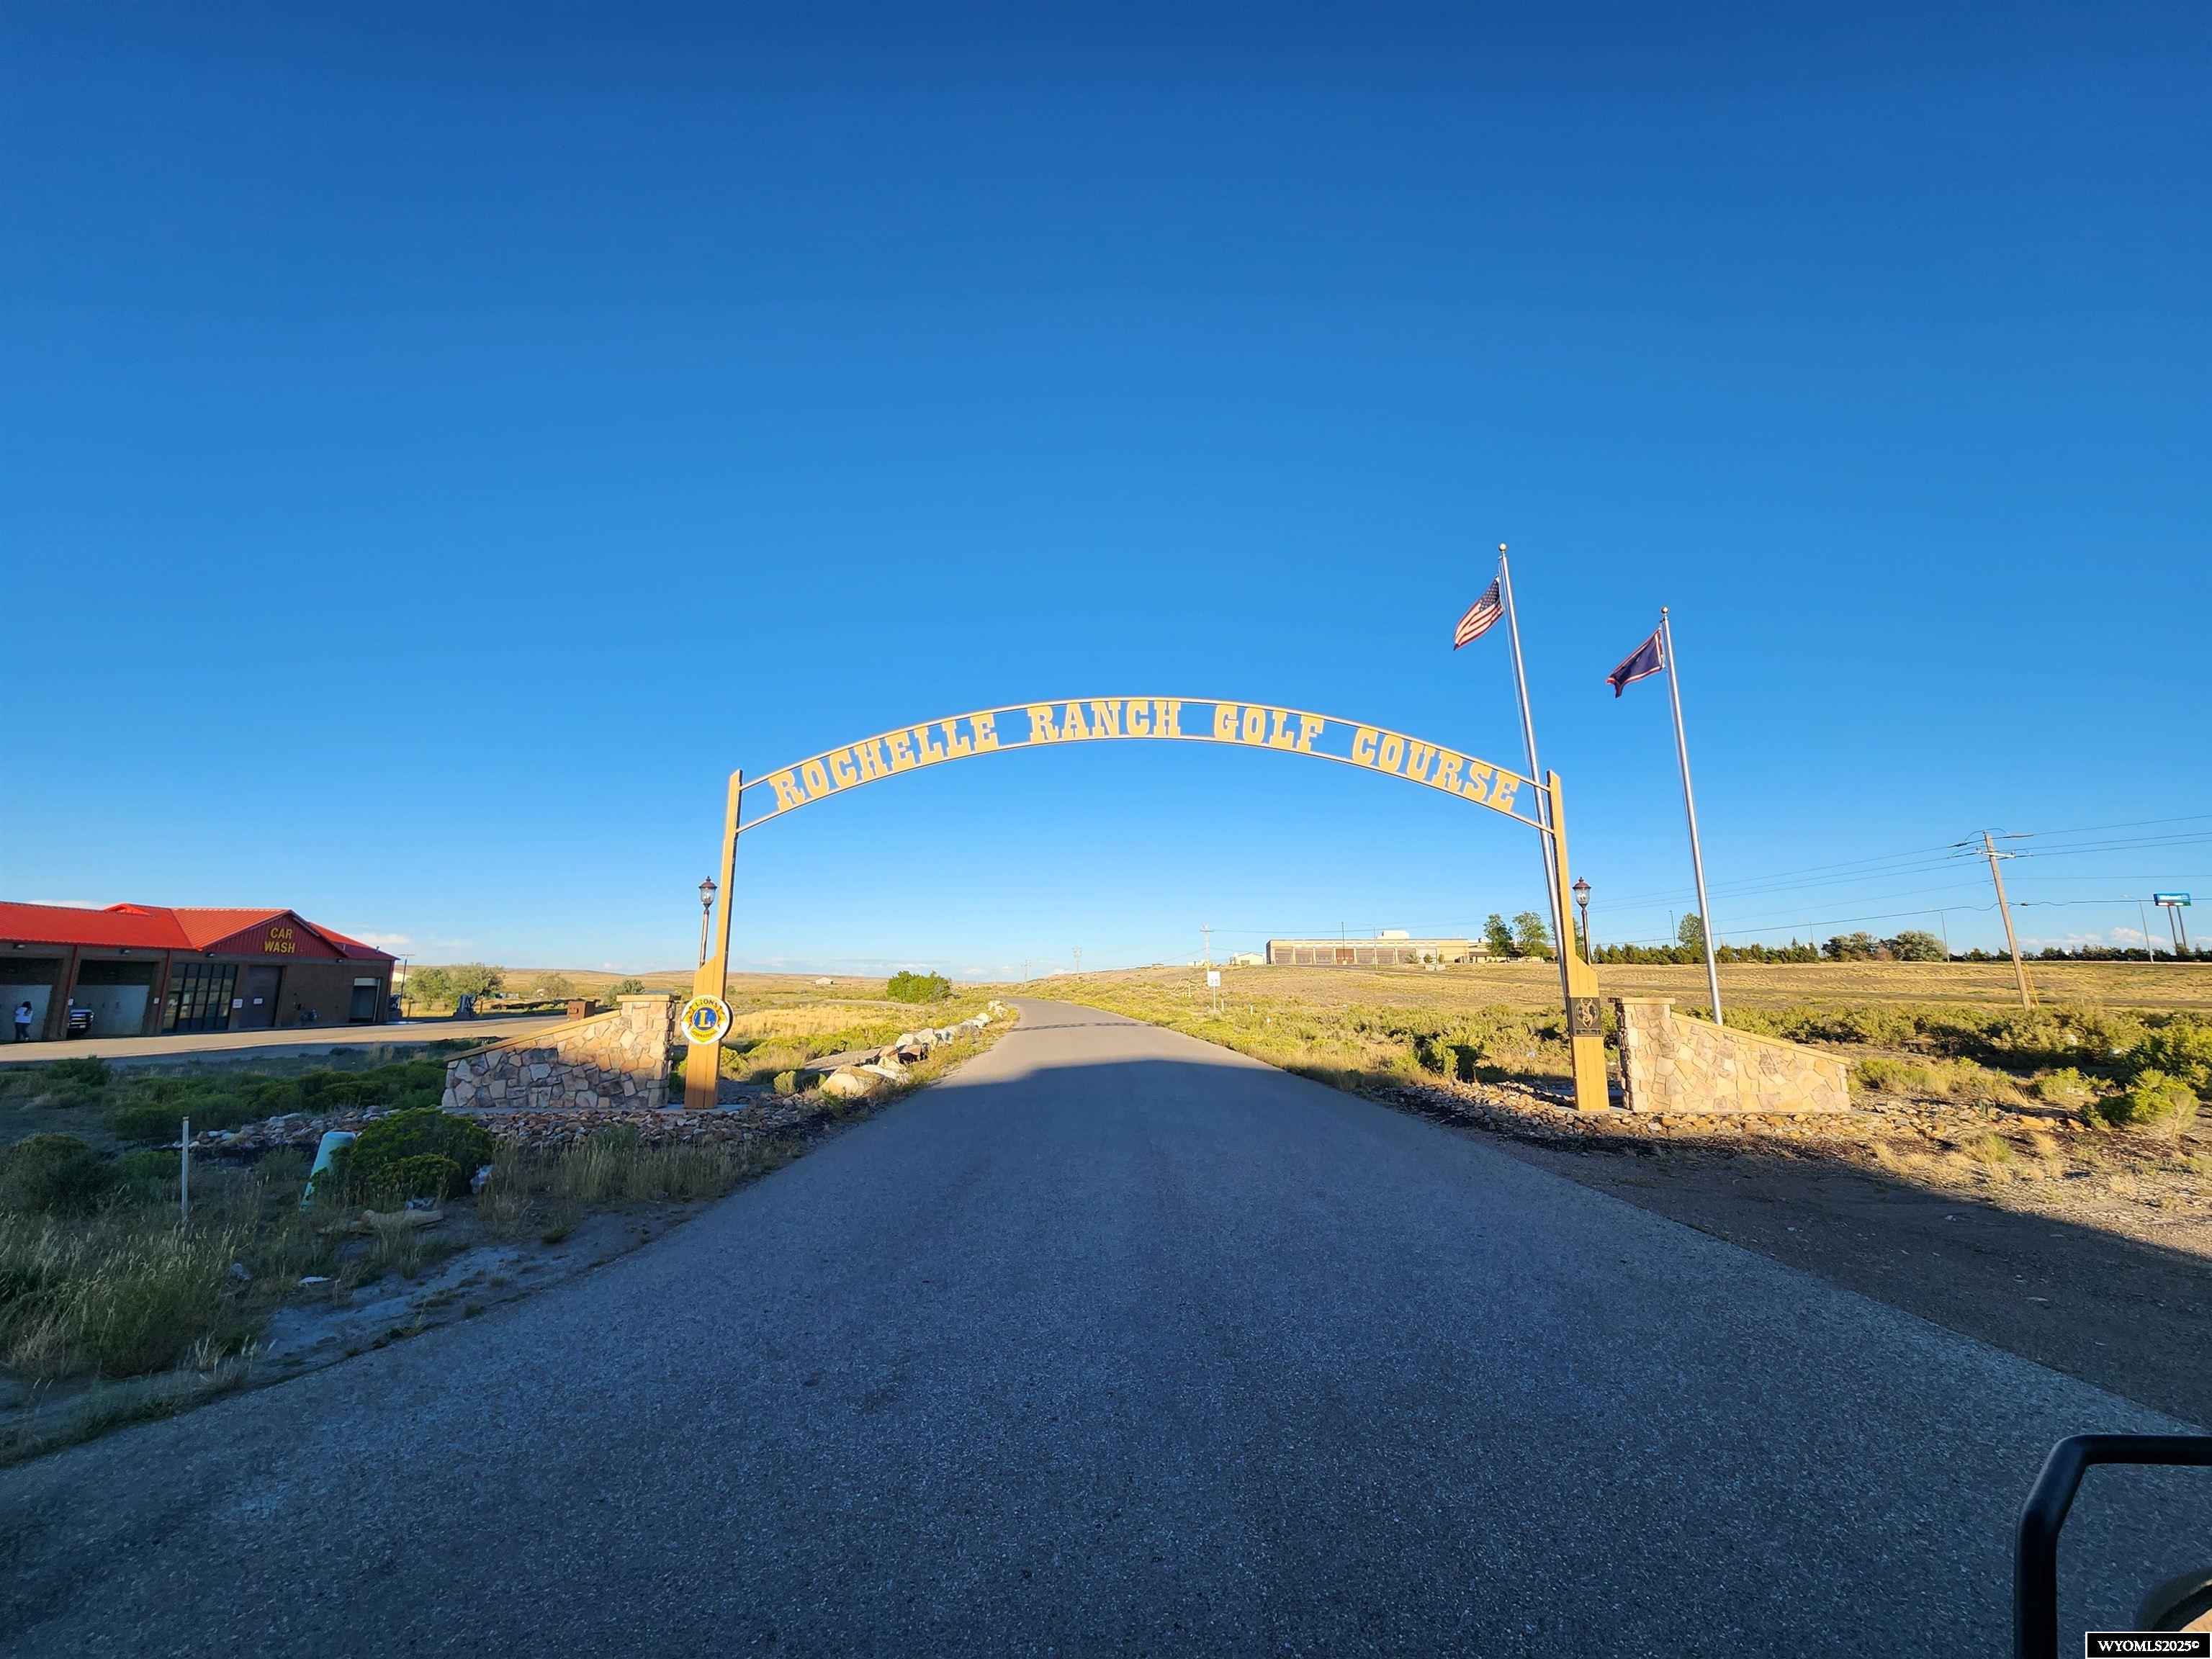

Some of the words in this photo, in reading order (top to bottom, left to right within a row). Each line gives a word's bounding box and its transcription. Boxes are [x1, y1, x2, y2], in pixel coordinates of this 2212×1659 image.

[768, 713, 999, 812] ROCHELLE
[1027, 700, 1182, 743] RANCH
[1213, 703, 1325, 752] GOLF
[1352, 727, 1521, 813] COURSE
[270, 927, 293, 940] CAR
[264, 940, 296, 953] WASH
[695, 998, 719, 1008] LIONS
[698, 1010, 711, 1028] L
